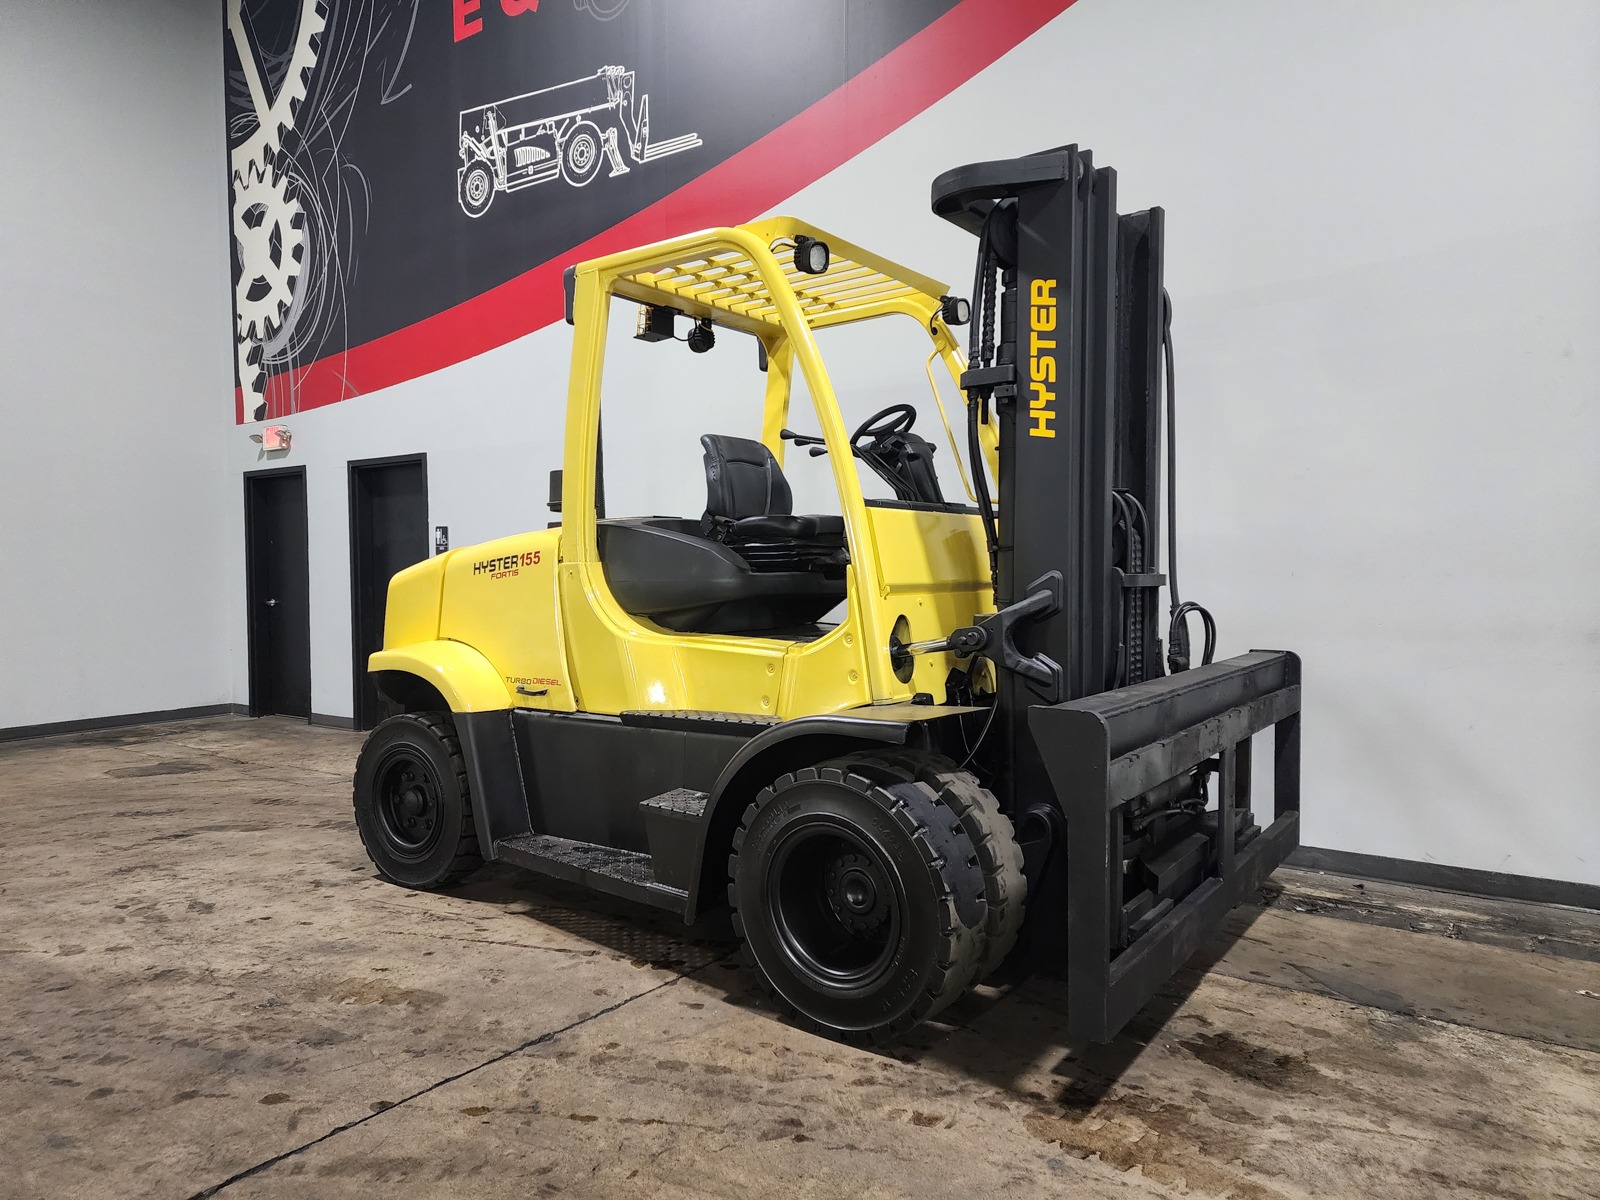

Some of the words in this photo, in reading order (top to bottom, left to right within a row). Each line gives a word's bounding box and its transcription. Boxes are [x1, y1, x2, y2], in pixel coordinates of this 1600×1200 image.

[1029, 278, 1057, 438] HYSTER
[473, 554, 519, 576] HYSTER
[490, 569, 519, 580] FORTIS
[532, 677, 562, 686] DIESEL
